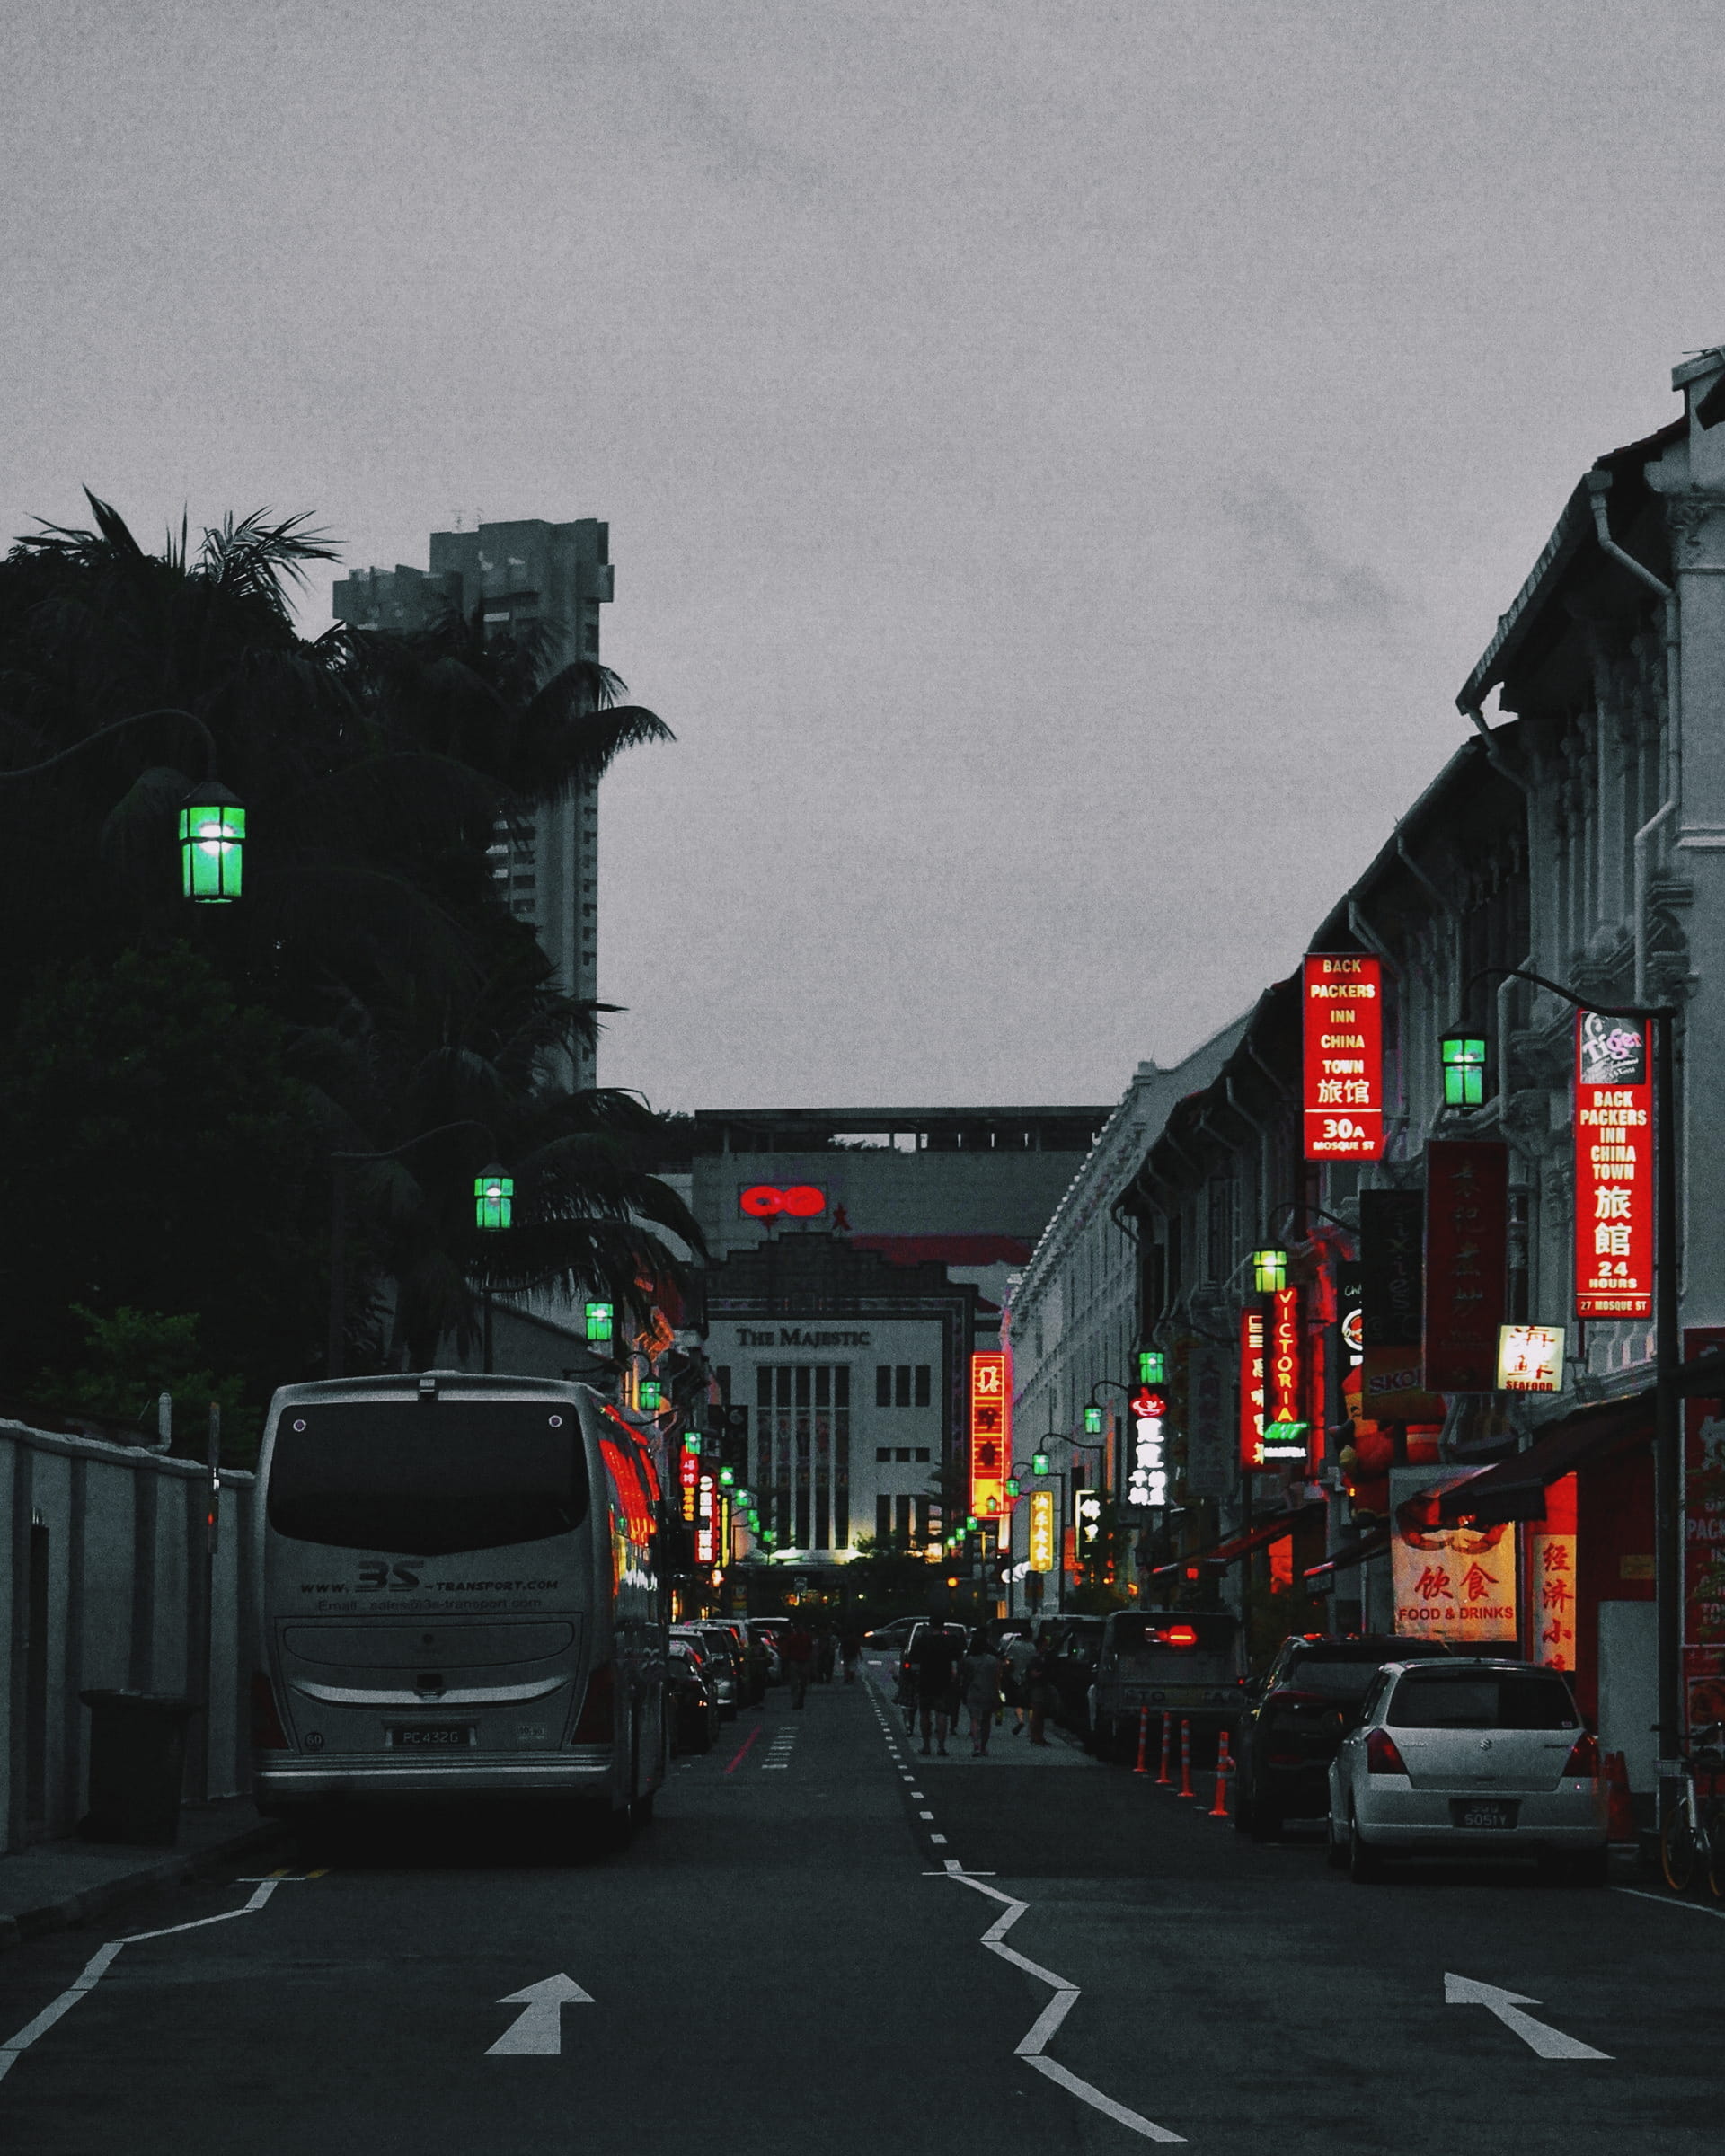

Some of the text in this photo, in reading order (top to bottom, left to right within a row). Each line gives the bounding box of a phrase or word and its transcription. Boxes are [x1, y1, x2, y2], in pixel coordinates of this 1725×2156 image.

[1322, 959, 1361, 973] BACK
[1310, 984, 1375, 998] PACKERS
[1331, 1010, 1355, 1023] INN
[1321, 1034, 1365, 1048] CHINA
[1322, 1060, 1364, 1074] TOWN
[1317, 1079, 1370, 1104] 旅馆
[1593, 1091, 1633, 1108] BACK
[1580, 1109, 1646, 1126] PACKERS
[1323, 1118, 1365, 1138] 30A
[1600, 1127, 1625, 1144] INN
[1313, 1141, 1375, 1152] MOSQUE ST
[1590, 1145, 1636, 1162] CHINA
[1592, 1163, 1634, 1180] TOWN
[1598, 1261, 1628, 1277] 24
[1588, 1278, 1637, 1288] HOURS
[1580, 1301, 1647, 1311] 27 MOSQUE ST
[1277, 1291, 1294, 1421] VICTORIA
[1506, 1381, 1553, 1392] SEAFOOD
[1399, 1606, 1514, 1621] FOOD & DRINKS
